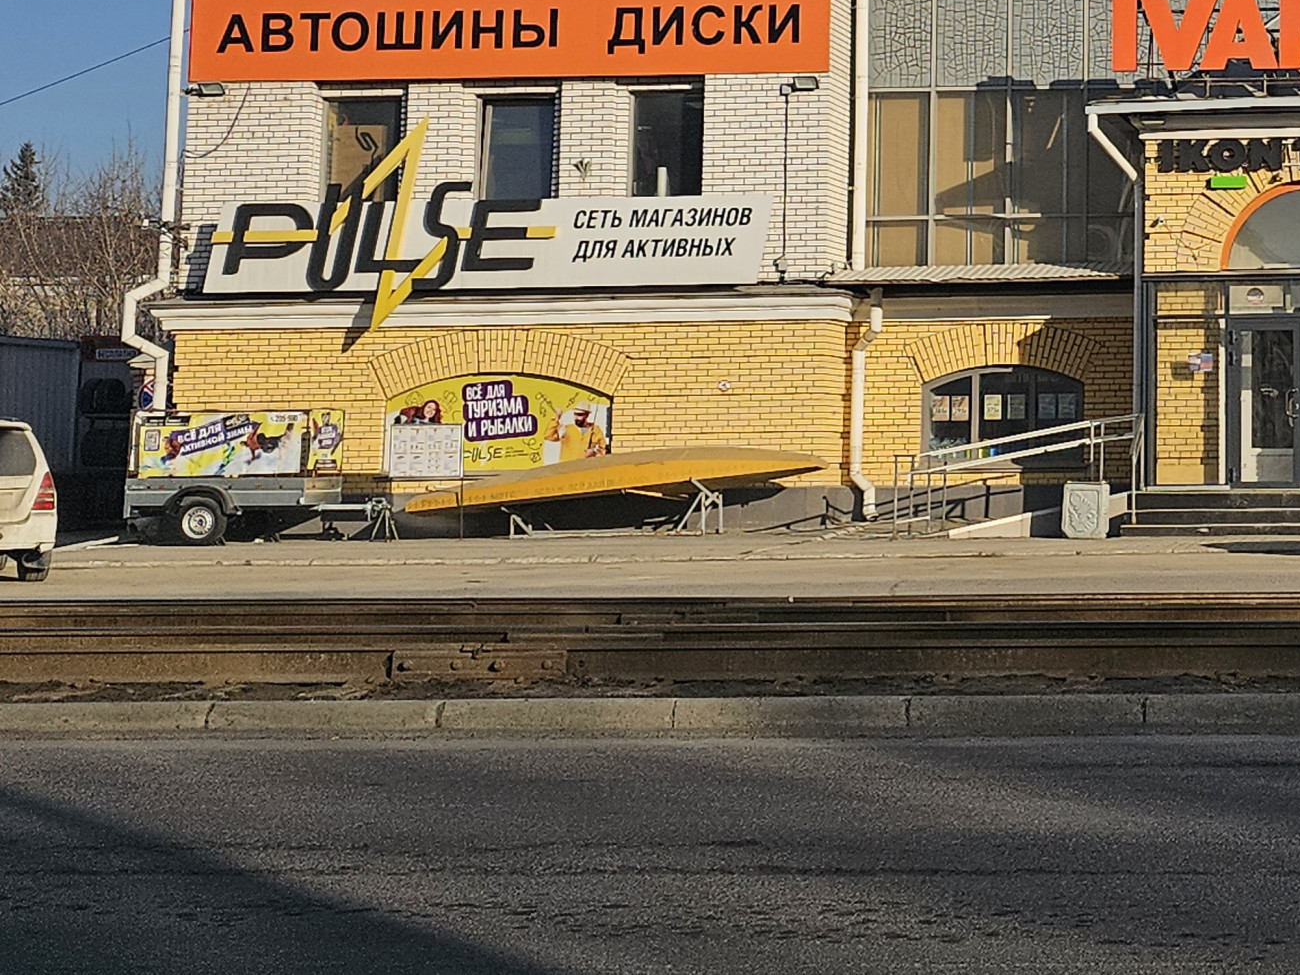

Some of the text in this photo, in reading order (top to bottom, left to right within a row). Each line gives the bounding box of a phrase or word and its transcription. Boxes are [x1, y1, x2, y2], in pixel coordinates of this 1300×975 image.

[216, 3, 802, 56] АВТОШИНЫ ДИСКИ
[1157, 137, 1284, 174] IKON
[573, 207, 753, 229] СЕТЬ МАГАЗИНОВ
[212, 177, 556, 295] PULSE
[572, 237, 737, 263] ДЛЯ АКТИВНЫХ
[465, 383, 506, 401] ВСЁ ДЛЯ
[465, 396, 524, 419] ТУРИЗМА
[177, 422, 222, 443] ВСЁ ДЛЯ
[467, 415, 533, 438] И РЫБАЛКИ
[179, 432, 225, 454] АКТИВНОЙ
